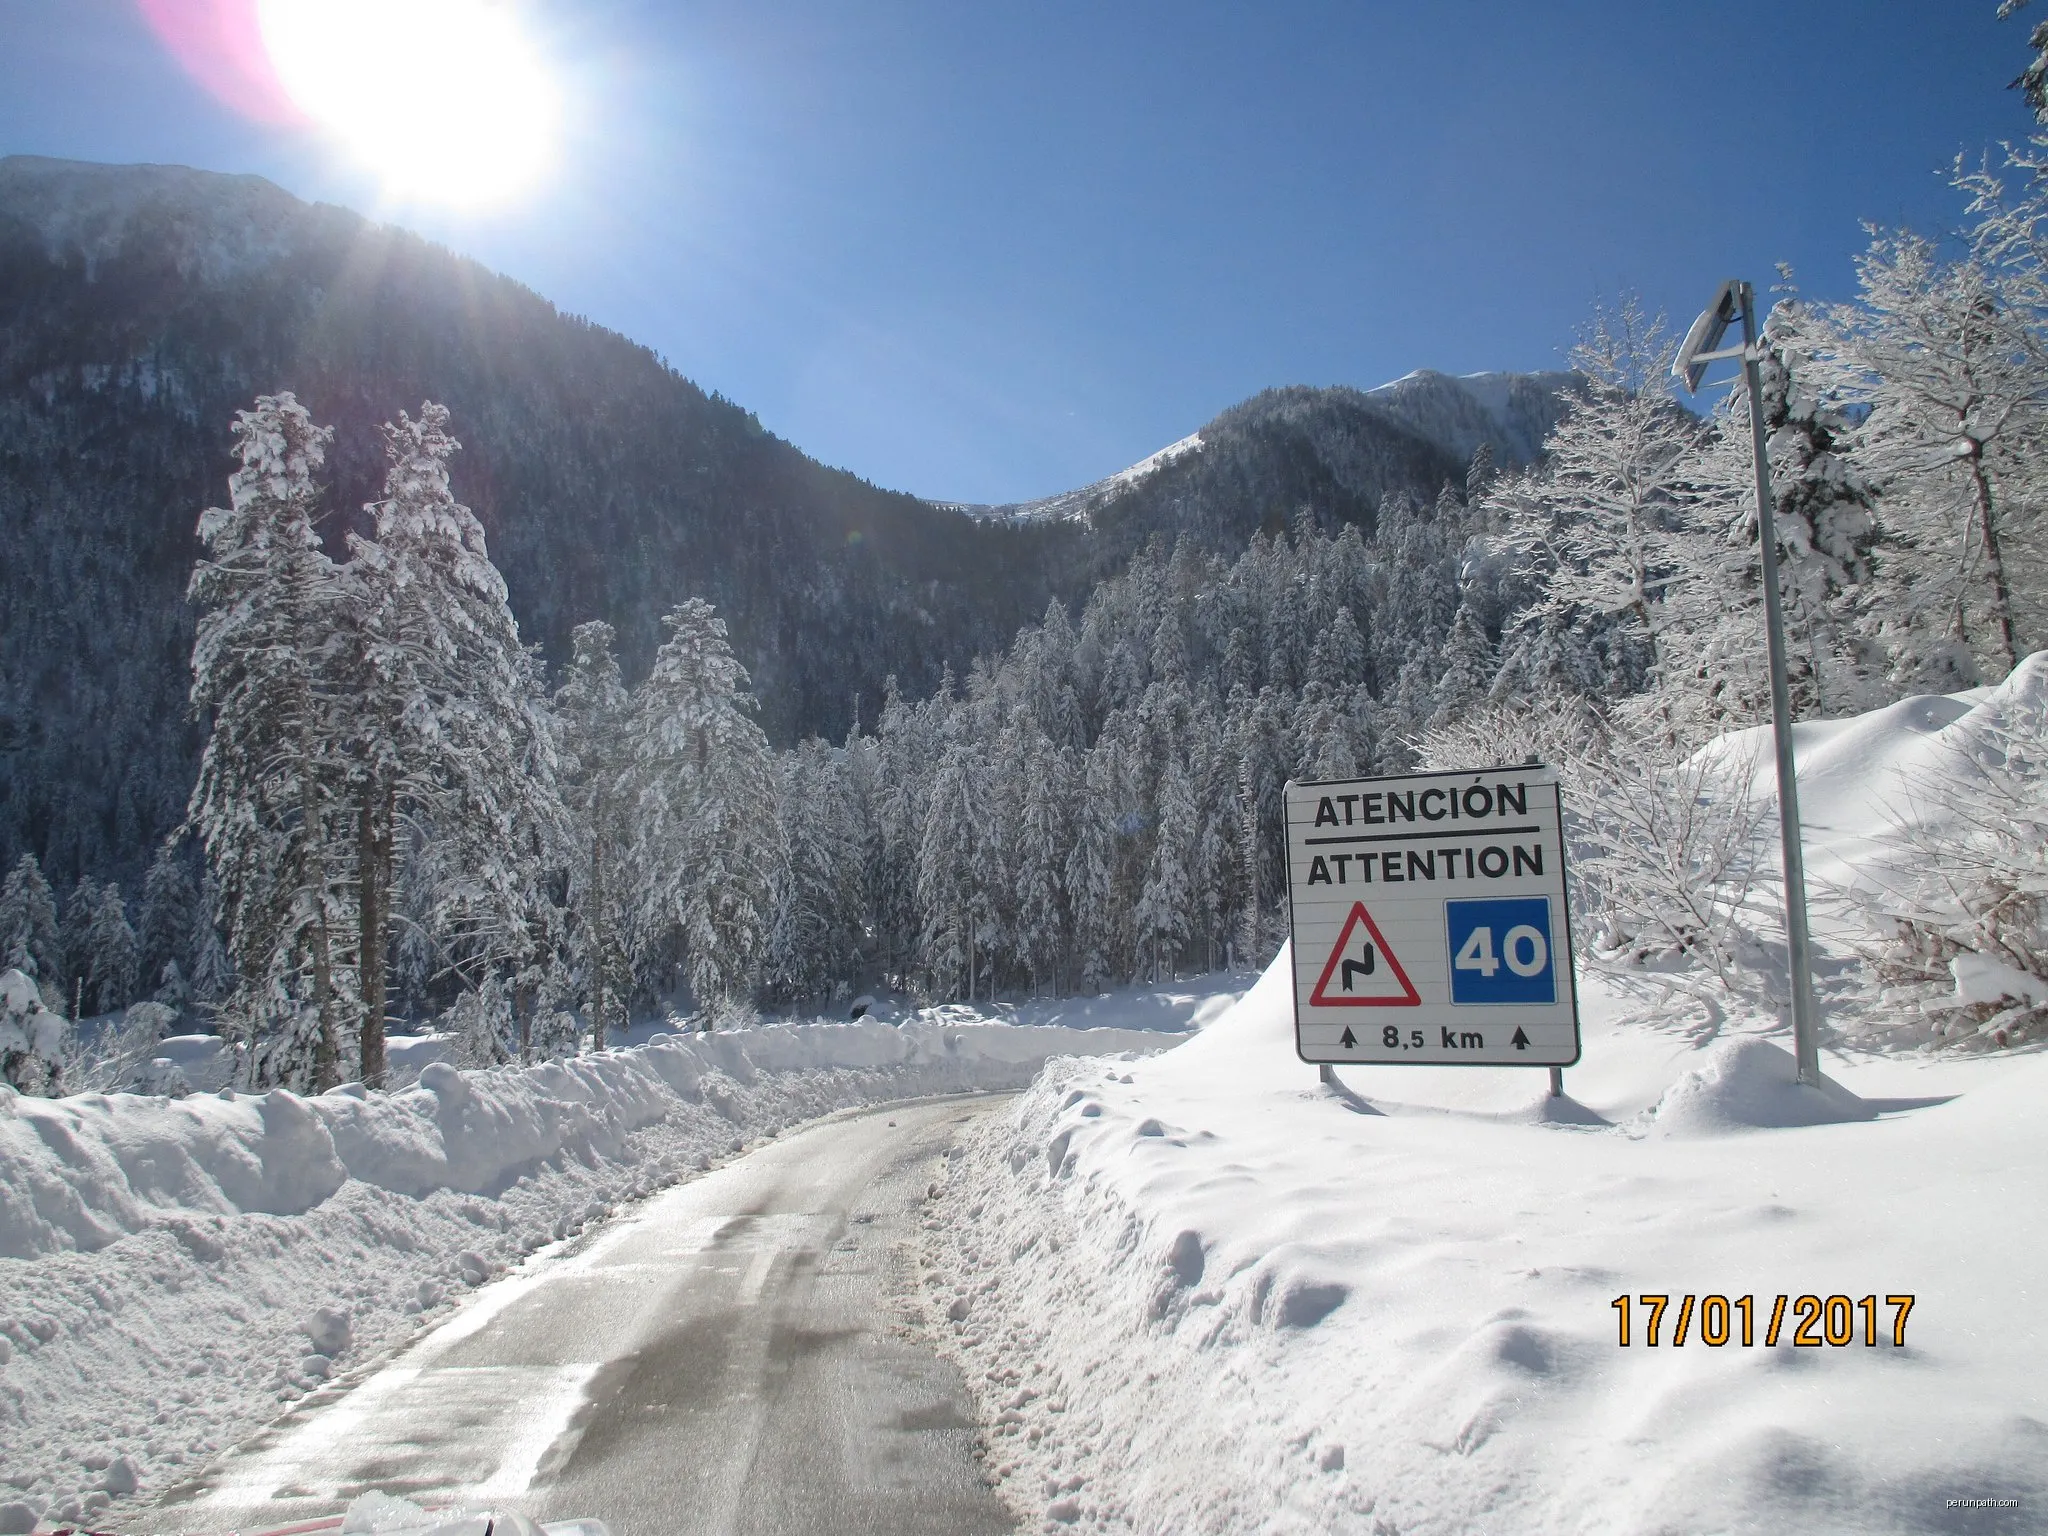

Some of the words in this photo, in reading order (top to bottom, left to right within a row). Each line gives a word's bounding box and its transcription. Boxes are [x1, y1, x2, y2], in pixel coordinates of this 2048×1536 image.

[1314, 777, 1528, 828] ATENCIÓN
[1307, 844, 1544, 886] ATTENTION
[1455, 924, 1547, 978] 40
[1382, 1025, 1424, 1050] 8,5
[1441, 1026, 1484, 1049] km
